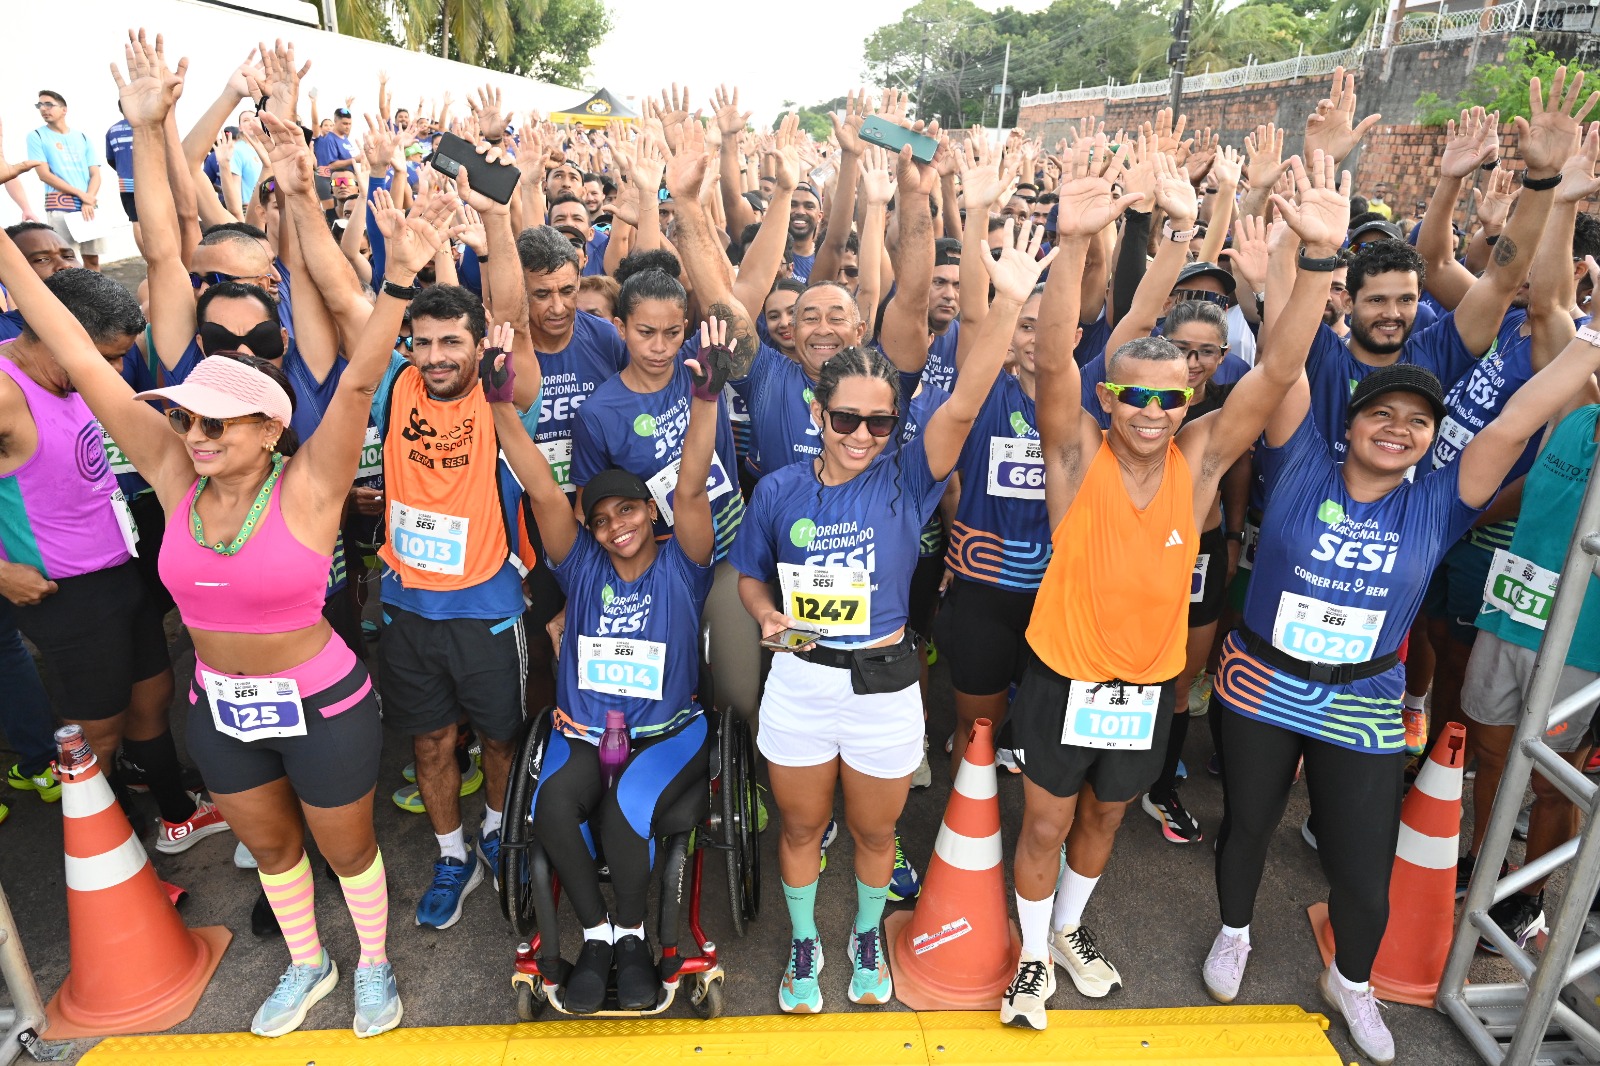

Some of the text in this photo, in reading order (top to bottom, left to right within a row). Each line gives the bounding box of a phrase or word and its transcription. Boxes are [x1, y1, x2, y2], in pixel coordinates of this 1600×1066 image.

[541, 381, 594, 397] ACIONAL DO
[537, 394, 592, 424] SES
[445, 456, 466, 467] SESI
[1008, 466, 1047, 487] 66
[808, 521, 859, 538] CORRIDA
[859, 526, 875, 543] DO
[1328, 521, 1400, 543] NACIONAL DO
[400, 532, 452, 562] 1013
[1294, 565, 1331, 588] CORRER
[1331, 580, 1352, 592] FAZ
[1365, 585, 1390, 598] BEM
[795, 596, 859, 621] 1247
[1292, 626, 1366, 660] 1020
[594, 663, 652, 687] 1014
[228, 705, 281, 729] 125
[1089, 712, 1142, 737] 1011
